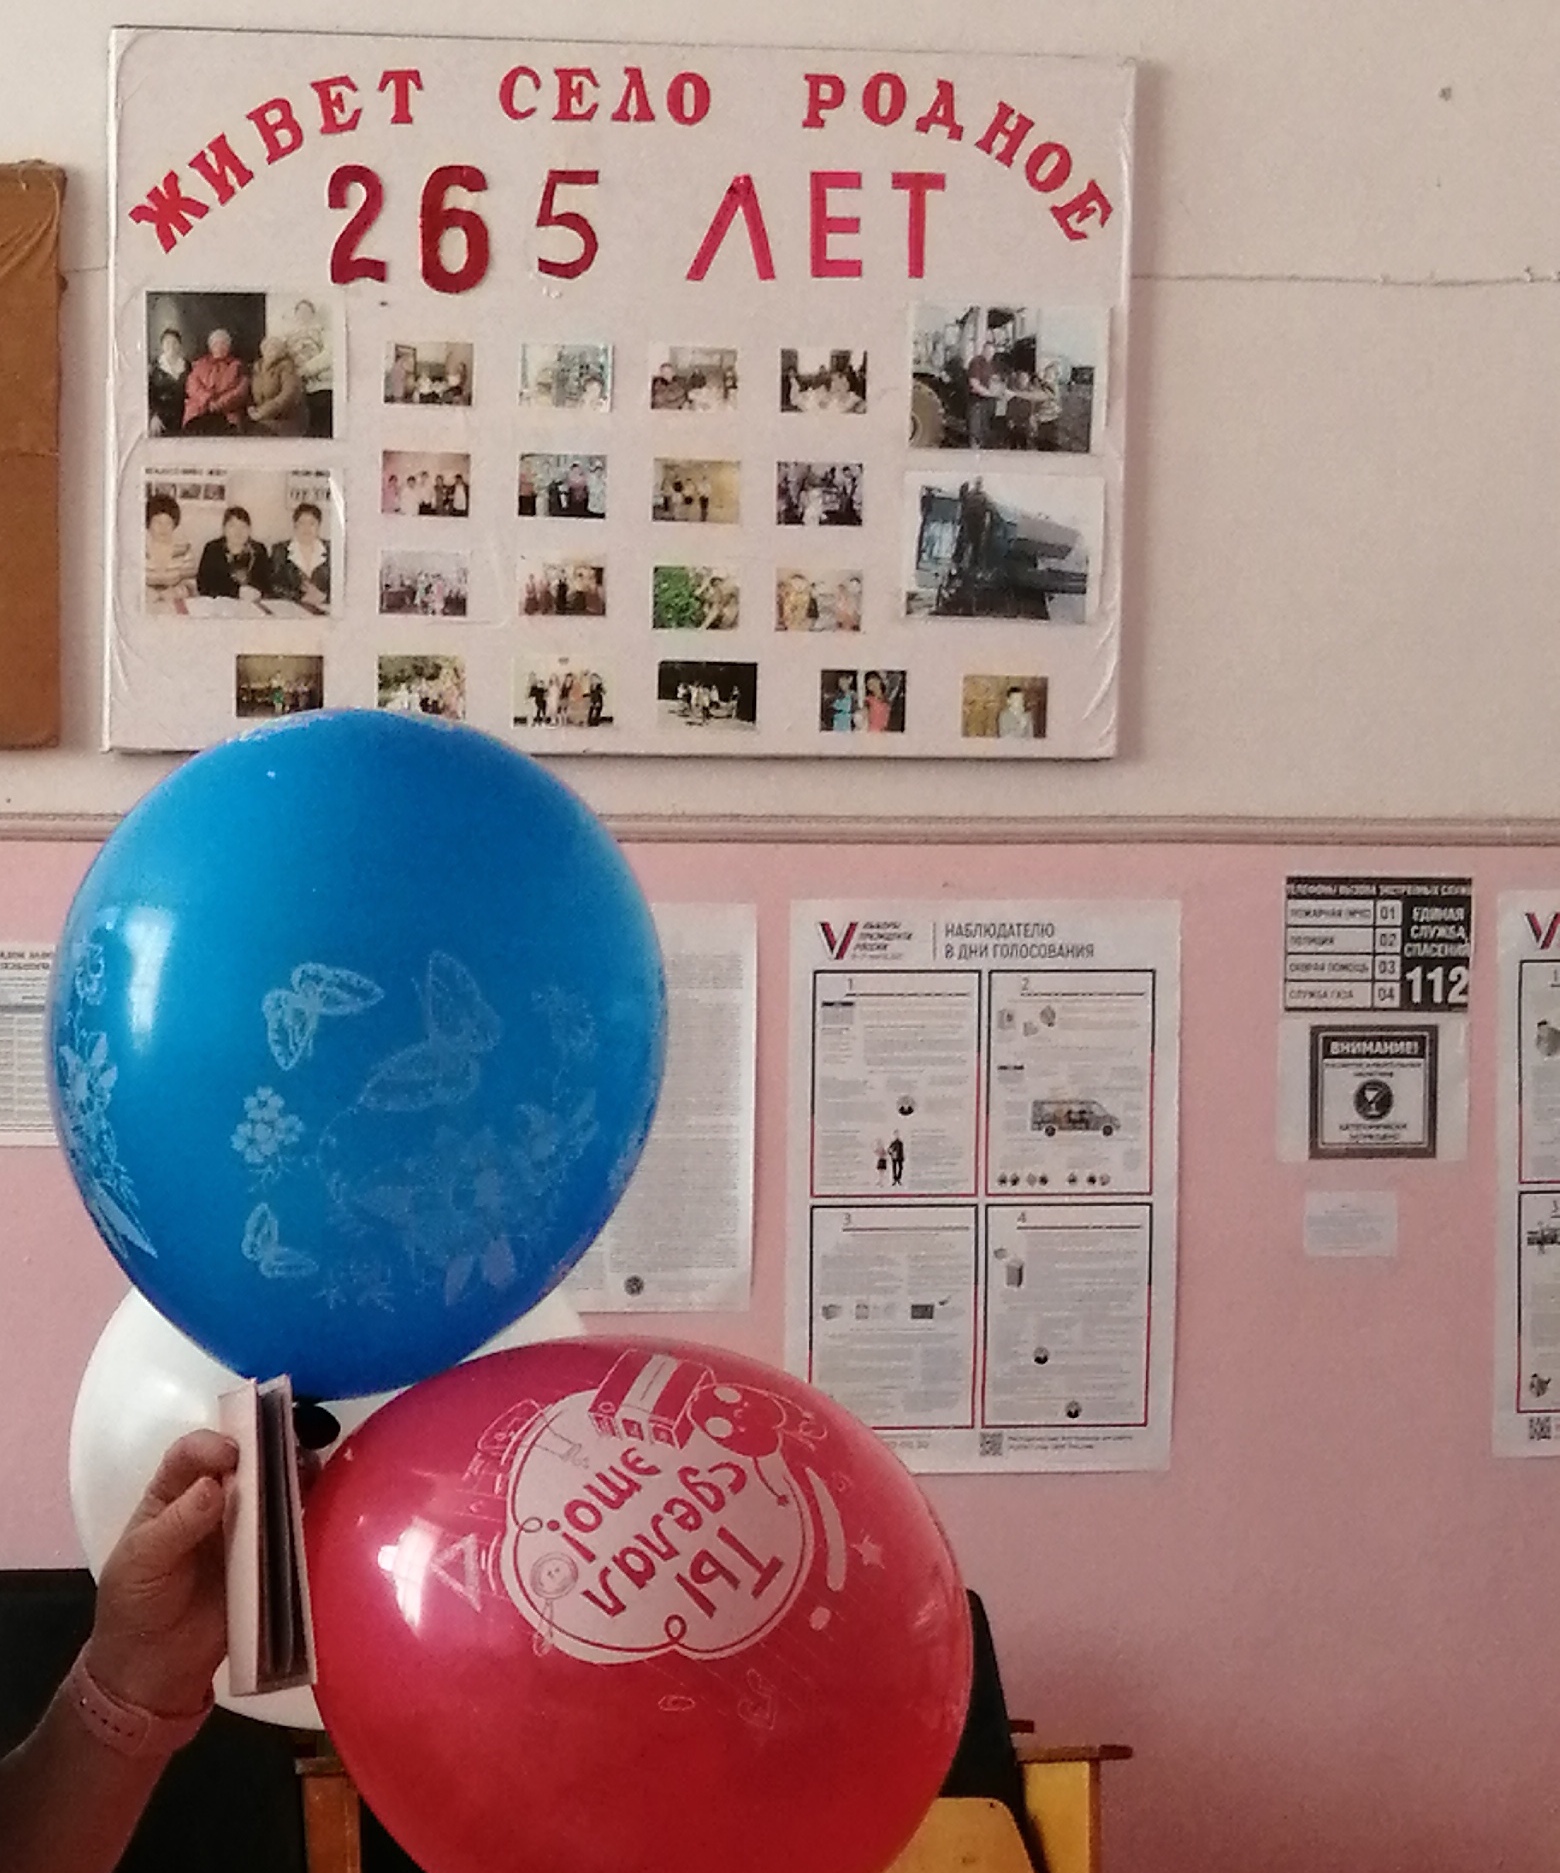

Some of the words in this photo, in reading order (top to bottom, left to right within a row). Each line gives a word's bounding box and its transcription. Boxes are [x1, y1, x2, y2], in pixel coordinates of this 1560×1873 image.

[129, 69, 423, 254] ЖИВЕТ
[498, 66, 711, 127] СЕЛО
[802, 71, 1115, 243] РОДНОЕ
[326, 165, 600, 294] 265
[686, 171, 947, 282] ЛЕТ
[1380, 906, 1397, 920] 01
[1412, 907, 1465, 922] ЕДИНАЯ
[945, 923, 1055, 939] НАБЛЮДАТЕЛЮ
[1410, 925, 1466, 940] СЛУЖБА
[1380, 933, 1397, 947] 02
[945, 944, 953, 958] В
[958, 944, 989, 960] ДНИ
[992, 944, 1094, 959] ГОЛОСОВАНИЯ
[1378, 960, 1396, 975] 03
[1405, 965, 1470, 1004] 112
[1378, 987, 1396, 1002] 04
[1330, 1041, 1419, 1056] ВНИМАНИЕ!
[581, 1461, 748, 1618] сделал
[675, 1526, 786, 1619] Ты
